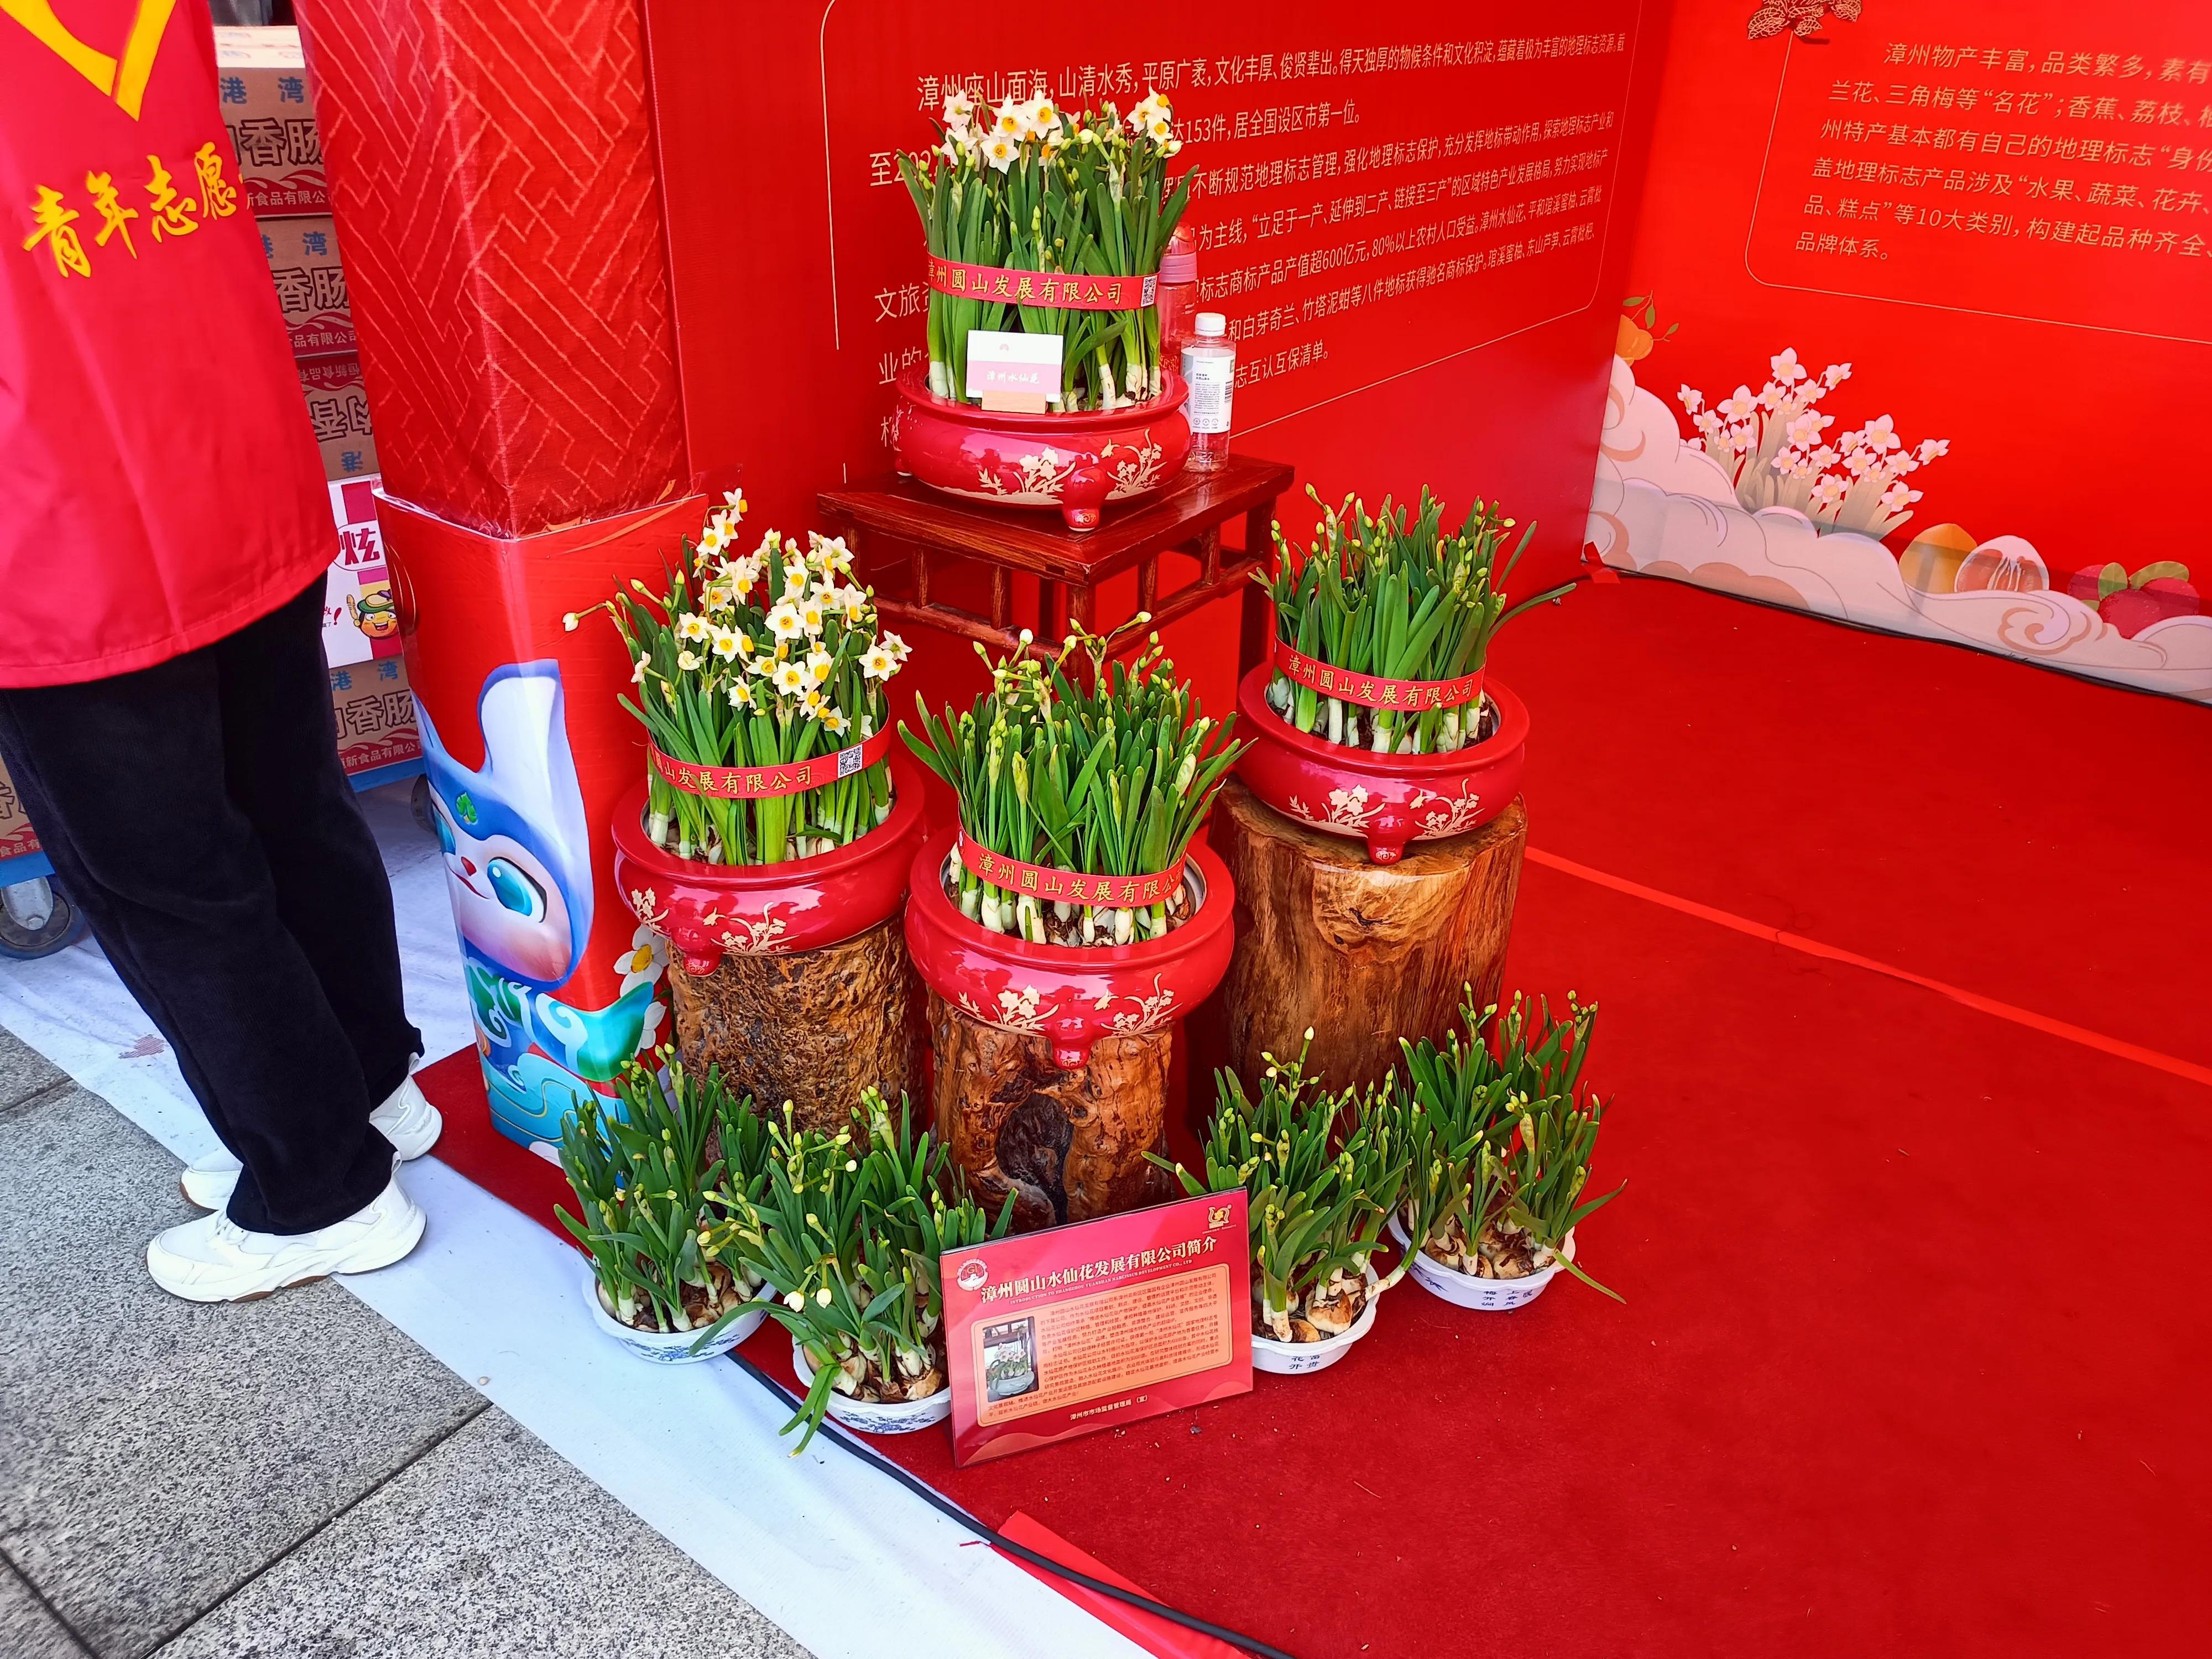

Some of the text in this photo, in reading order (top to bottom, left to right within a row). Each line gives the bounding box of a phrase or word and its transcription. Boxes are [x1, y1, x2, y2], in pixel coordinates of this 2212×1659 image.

[23, 142, 249, 278] 青年志愿
[1191, 148, 1608, 251] 为主线，“立足于一产、延伸到二产、链接至三产”的区域特色产业发展格局，努力实现地标产
[1195, 185, 1603, 303] 标志商标产品产值超600亿元，80%以上农村人口受益。漳州水仙花、平和琯溪蜜柚、云霄枇
[1795, 231, 1888, 260] 品牌体系。
[290, 332, 357, 348] 品有限公司
[340, 528, 380, 566] 炫
[1288, 654, 1473, 707] 漳州圆山发展有限公司
[979, 853, 1183, 903] 漳州圆山发展有限公司
[981, 1235, 1217, 1303] 漳州圆山水仙花发展有限公司简介
